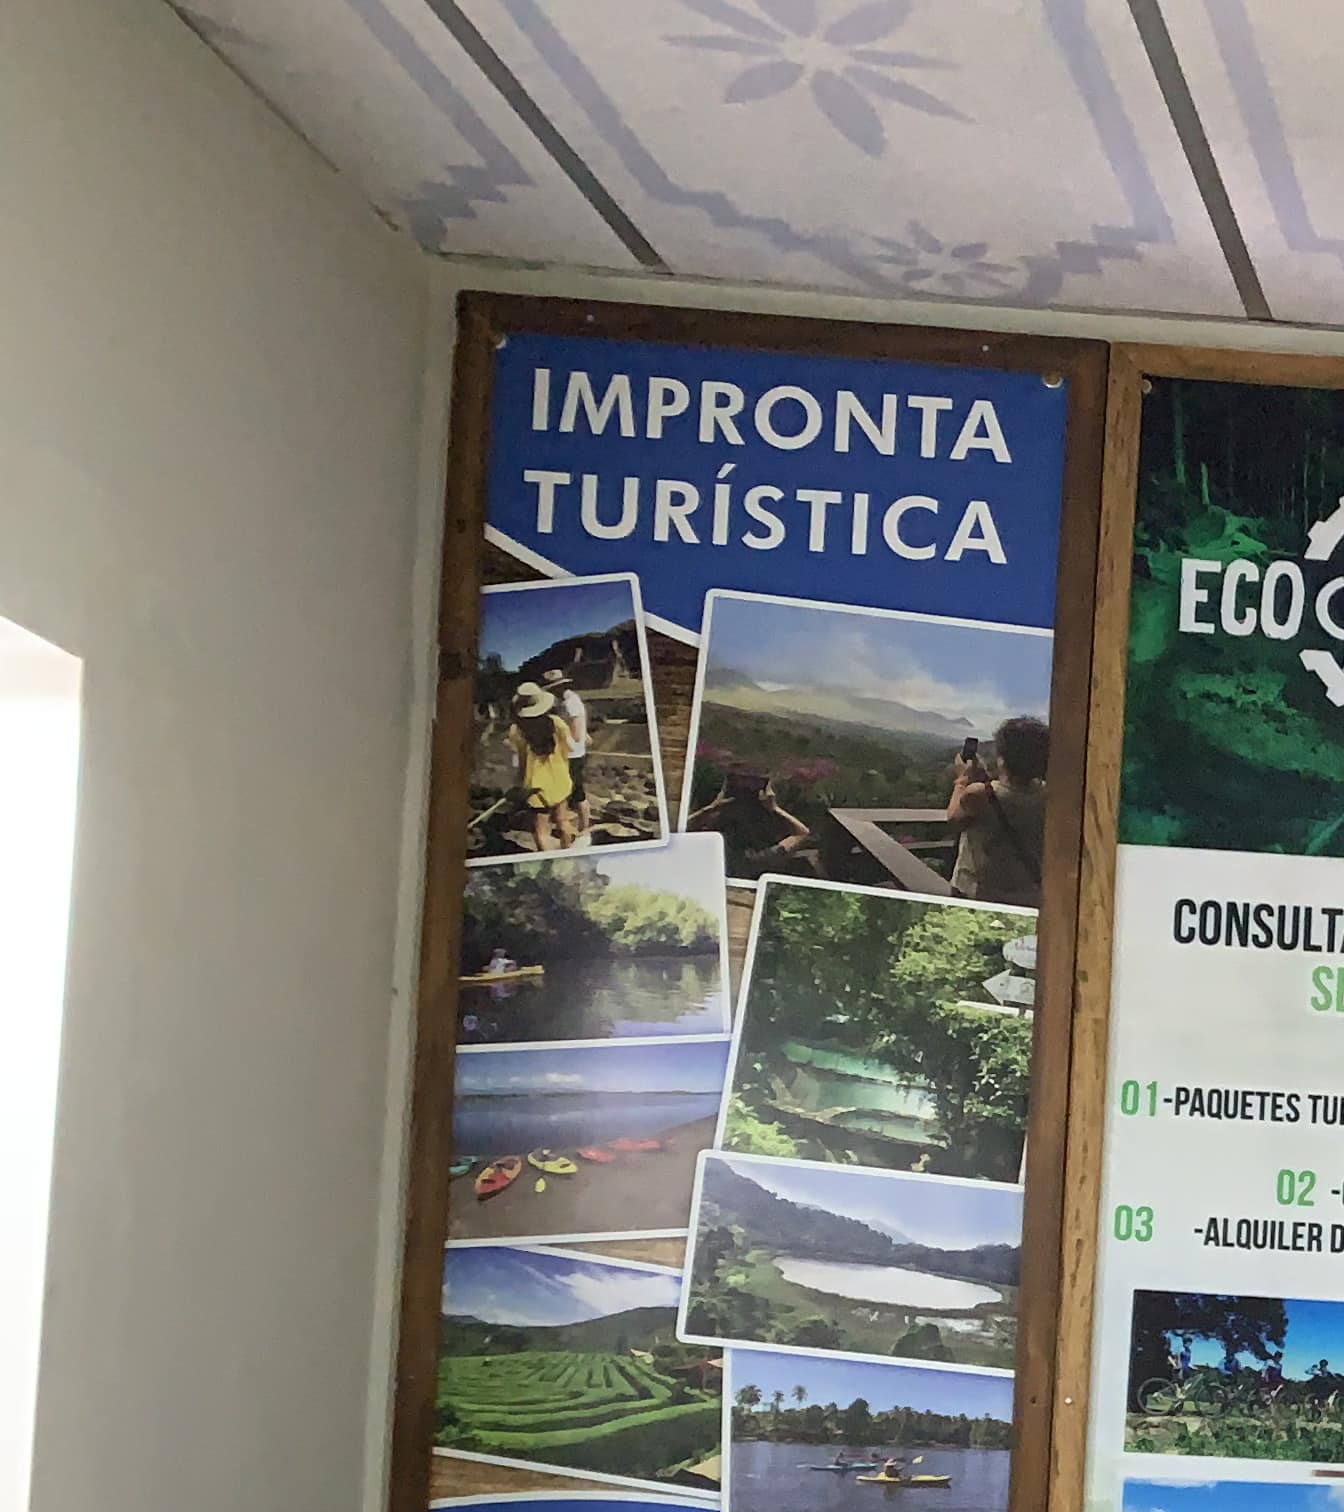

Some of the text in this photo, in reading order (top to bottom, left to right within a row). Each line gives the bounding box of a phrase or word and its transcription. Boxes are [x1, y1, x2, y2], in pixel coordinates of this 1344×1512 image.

[531, 368, 1012, 464] IMPRONTA
[523, 463, 1008, 565] TURÍSTICA
[1276, 1168, 1317, 1208] 02
[1113, 1205, 1154, 1243] 03
[1194, 1216, 1323, 1254] -ALQUILER
